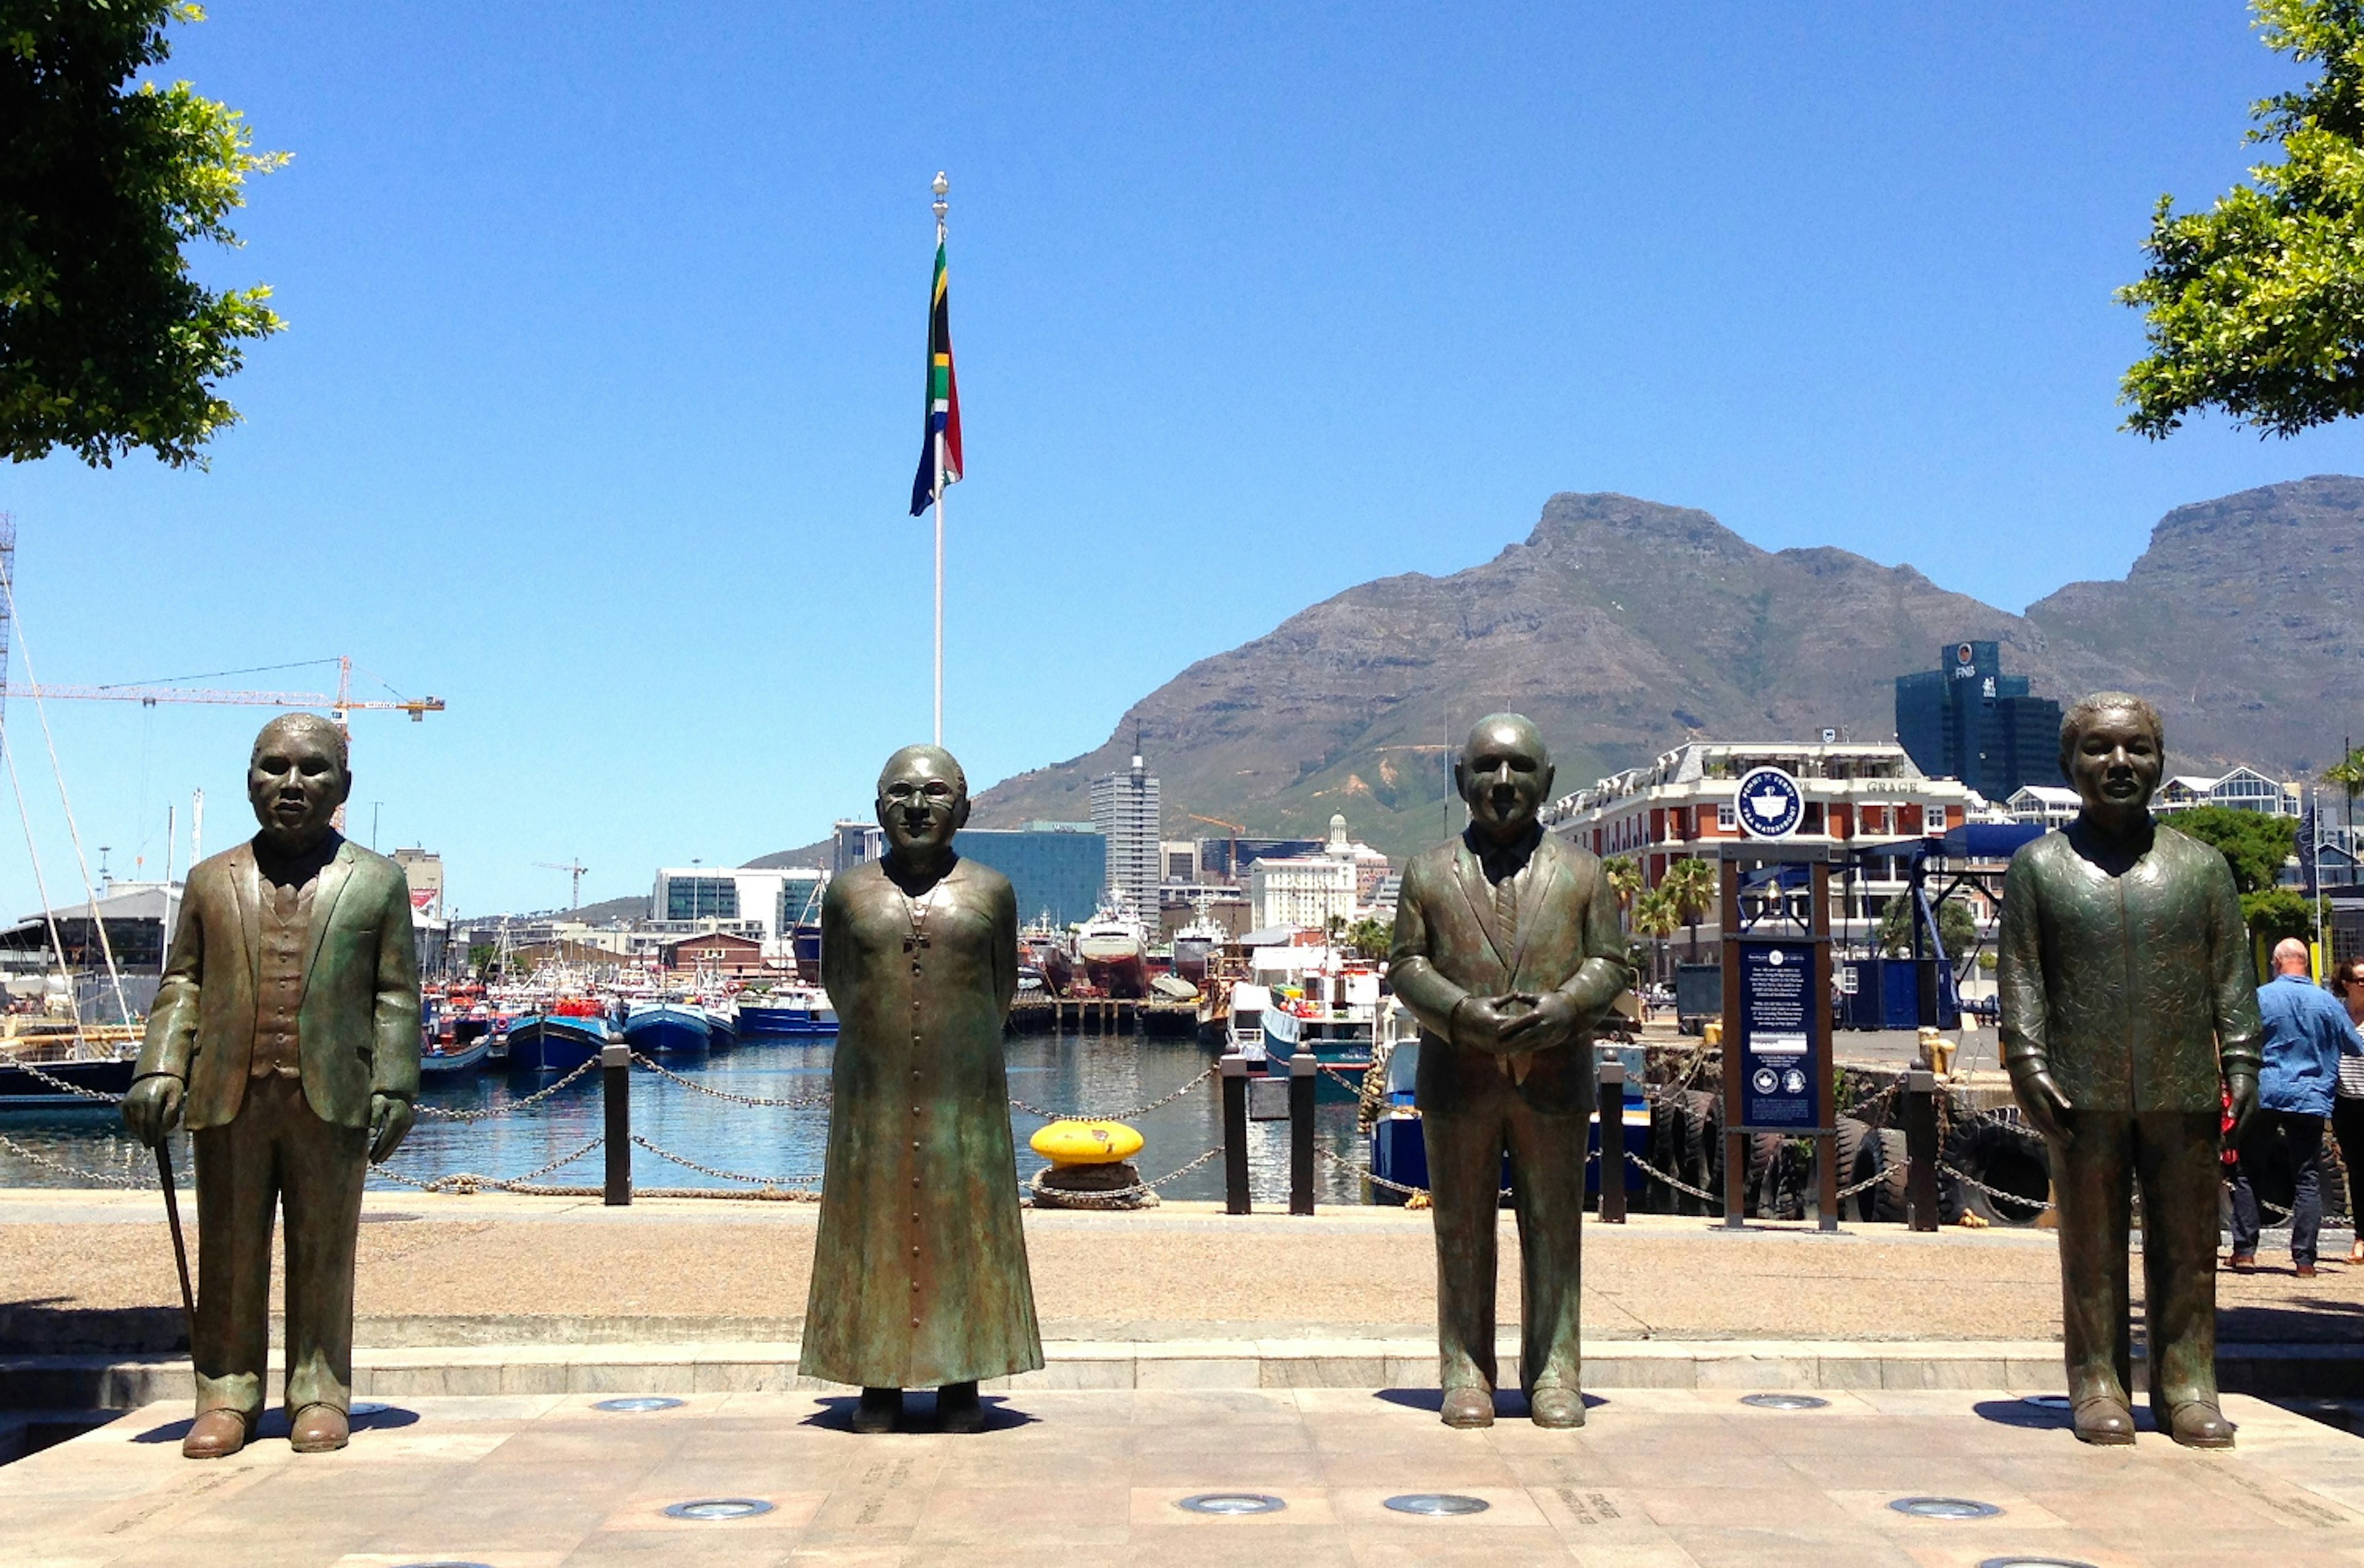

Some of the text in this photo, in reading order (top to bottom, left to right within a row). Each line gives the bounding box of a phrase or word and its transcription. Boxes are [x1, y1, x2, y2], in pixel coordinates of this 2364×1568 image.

[1955, 665, 1976, 679] FNB
[1742, 776, 1795, 798] PENNY FERRY
[1867, 781, 1918, 793] GRACE
[1755, 805, 1797, 834] WATERFRONT
